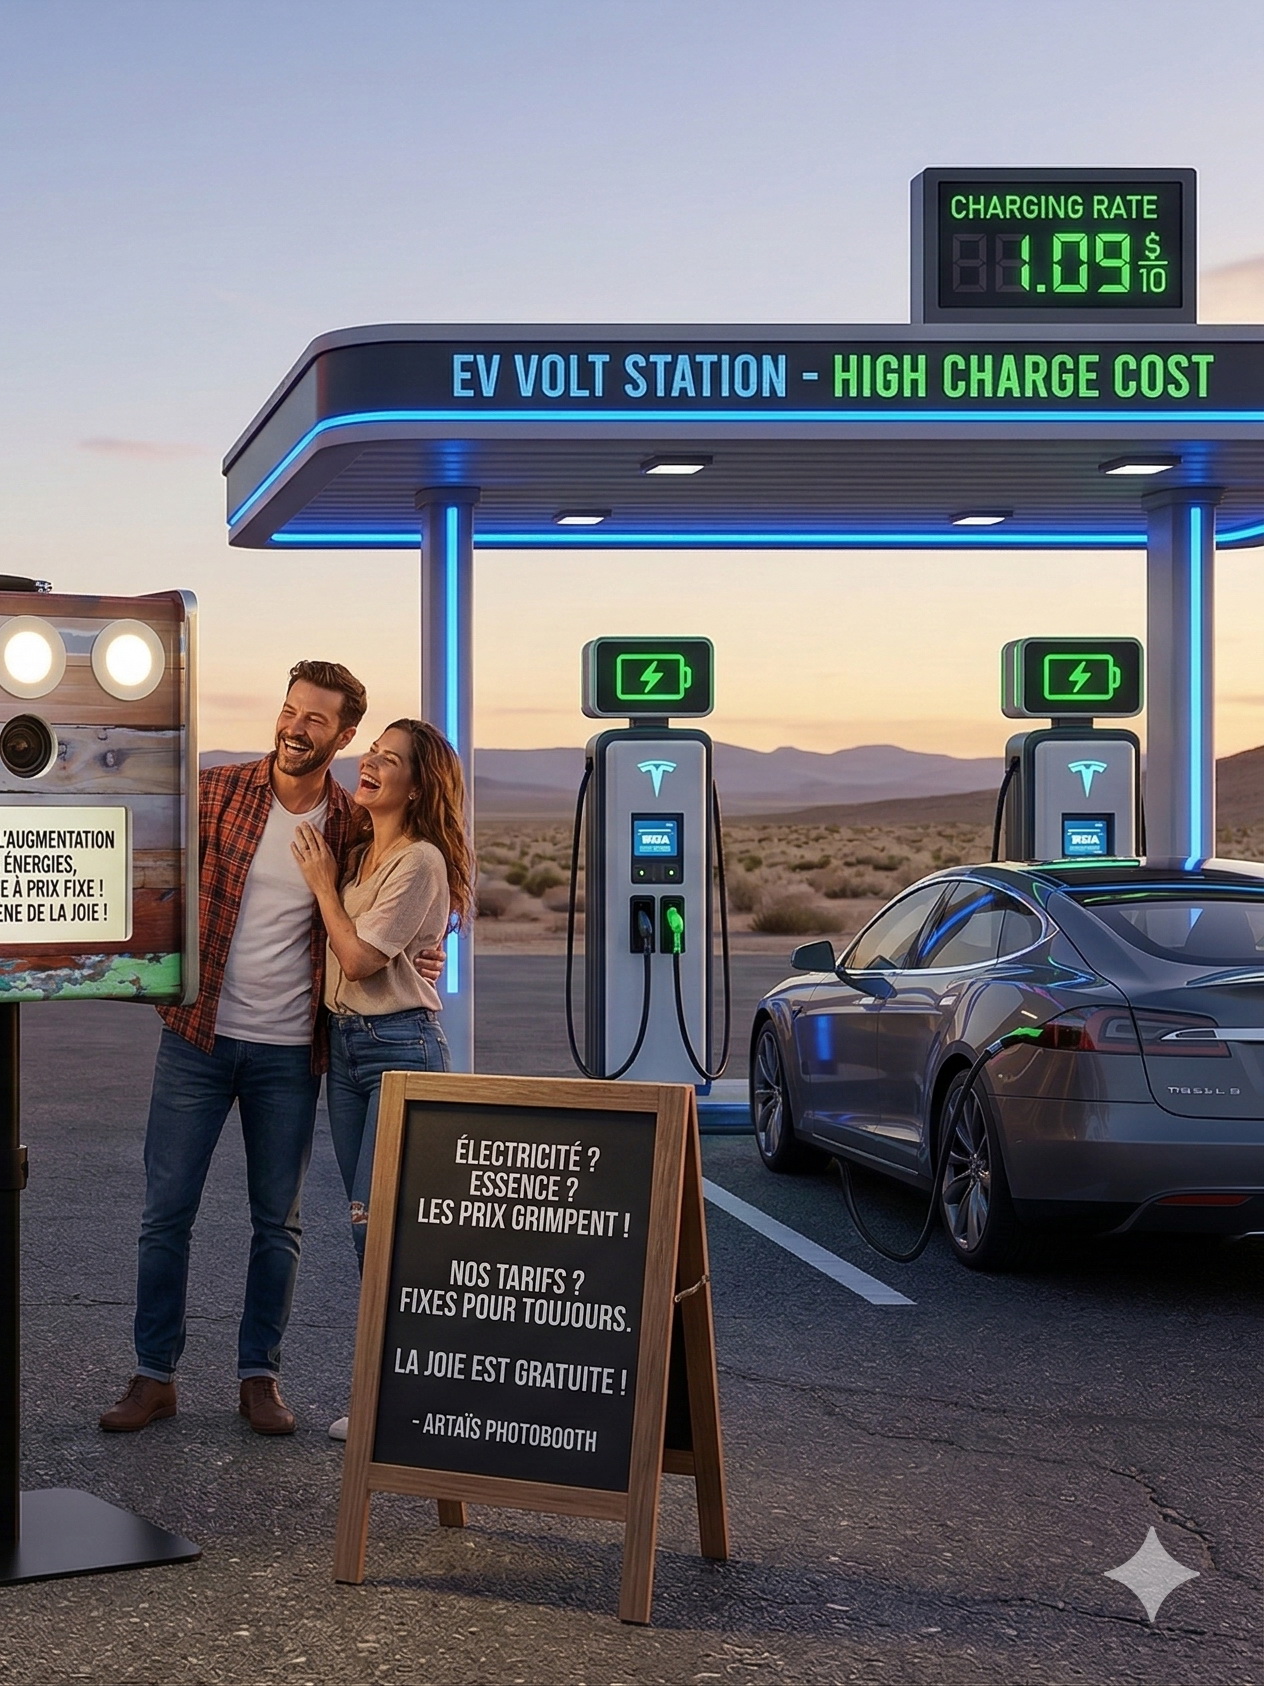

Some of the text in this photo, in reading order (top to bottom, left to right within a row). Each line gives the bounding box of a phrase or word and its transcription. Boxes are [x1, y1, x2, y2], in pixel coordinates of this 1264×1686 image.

[951, 195, 1158, 219] CHARGING RATE
[1021, 233, 1130, 293] 1.09
[453, 354, 501, 398] EV
[514, 354, 610, 398] VOLT
[624, 354, 786, 398] STATION
[833, 354, 927, 398] HIGH
[942, 354, 1100, 398] CHARGE
[1112, 354, 1215, 398] COST
[4, 851, 77, 877] ÉNERGIES,
[12, 874, 23, 898] À
[27, 879, 60, 898] PRIX
[64, 879, 94, 897] FIXE
[27, 903, 46, 922] DE
[49, 903, 67, 922] LA
[70, 903, 99, 922] JOIE
[455, 1134, 583, 1171] ÉLECTRICITÉ
[469, 1170, 561, 1201] ESSENCE
[417, 1198, 455, 1225] LES
[458, 1201, 507, 1229] PRIX
[511, 1204, 619, 1238] GRIMPENT
[449, 1259, 491, 1288] NOS
[496, 1263, 567, 1295] TARIFS
[399, 1287, 632, 1333] FIXES POUR TOUJOURS.
[394, 1347, 419, 1375] LA
[423, 1350, 467, 1380] JOIE
[471, 1354, 511, 1384] EST
[514, 1359, 615, 1395] GRATUITE
[422, 1412, 482, 1440] ARTAÏS
[485, 1419, 598, 1452] PHOTOBOOTH
